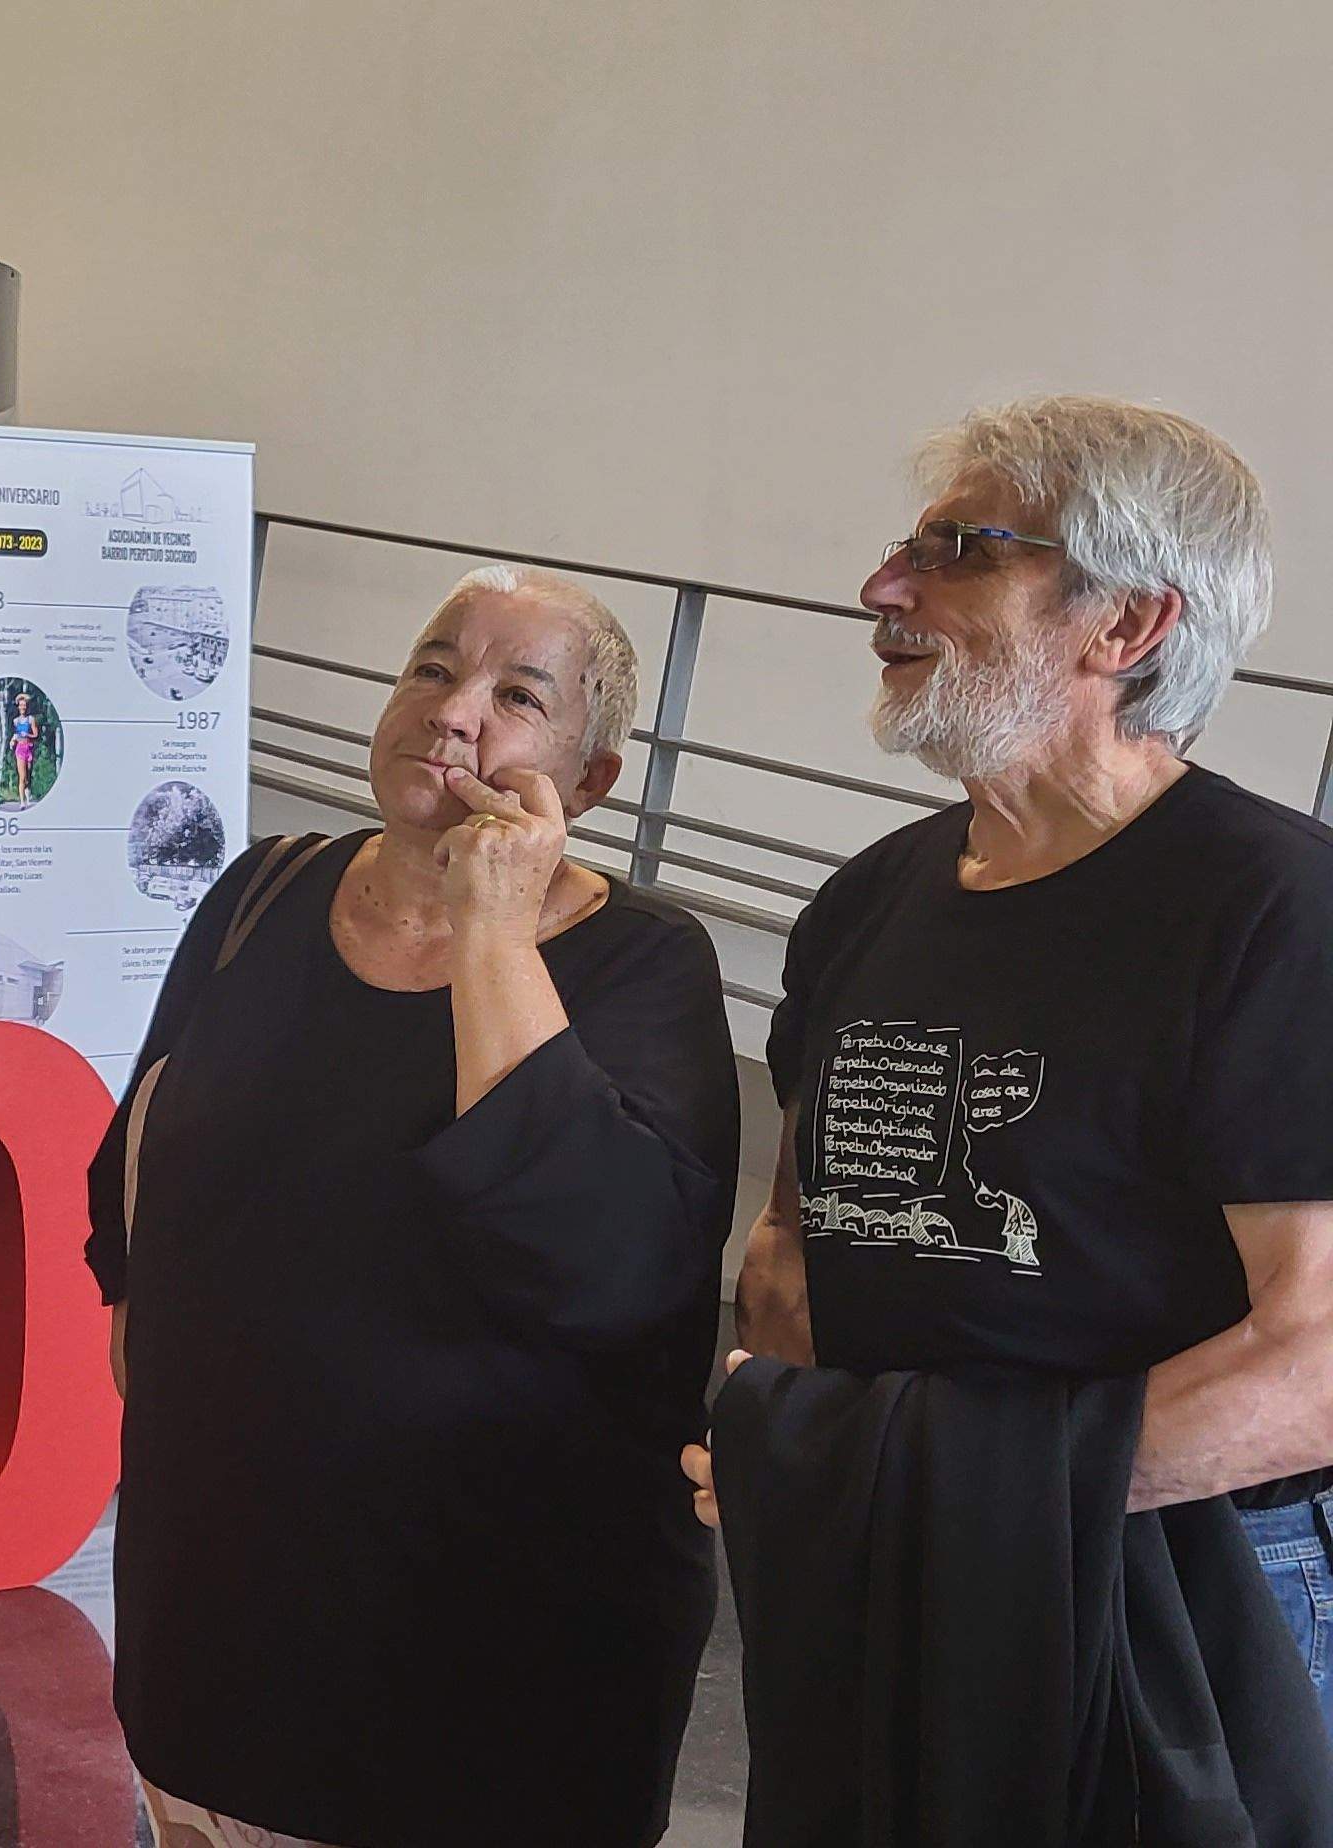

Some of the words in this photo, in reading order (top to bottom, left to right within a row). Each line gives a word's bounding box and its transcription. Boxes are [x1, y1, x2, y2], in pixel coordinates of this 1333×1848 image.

[153, 531, 161, 545] DE
[162, 532, 191, 547] VECINOS
[101, 546, 128, 561] BARRIO
[129, 547, 163, 562] PERPETUO
[164, 549, 197, 564] SOCORRO
[176, 711, 221, 730] 1987
[840, 1033, 952, 1058] PerpetuOscense
[832, 1055, 945, 1076] PerpetuOrdenado
[999, 1064, 1026, 1078] de
[829, 1075, 948, 1099] PerpetuOrganizado
[970, 1085, 1002, 1100] cosas
[1004, 1084, 1031, 1101] que
[827, 1093, 936, 1122] PerpetuOriginal
[971, 1105, 1002, 1119] eres
[824, 1113, 938, 1145] PerpetuOptimista
